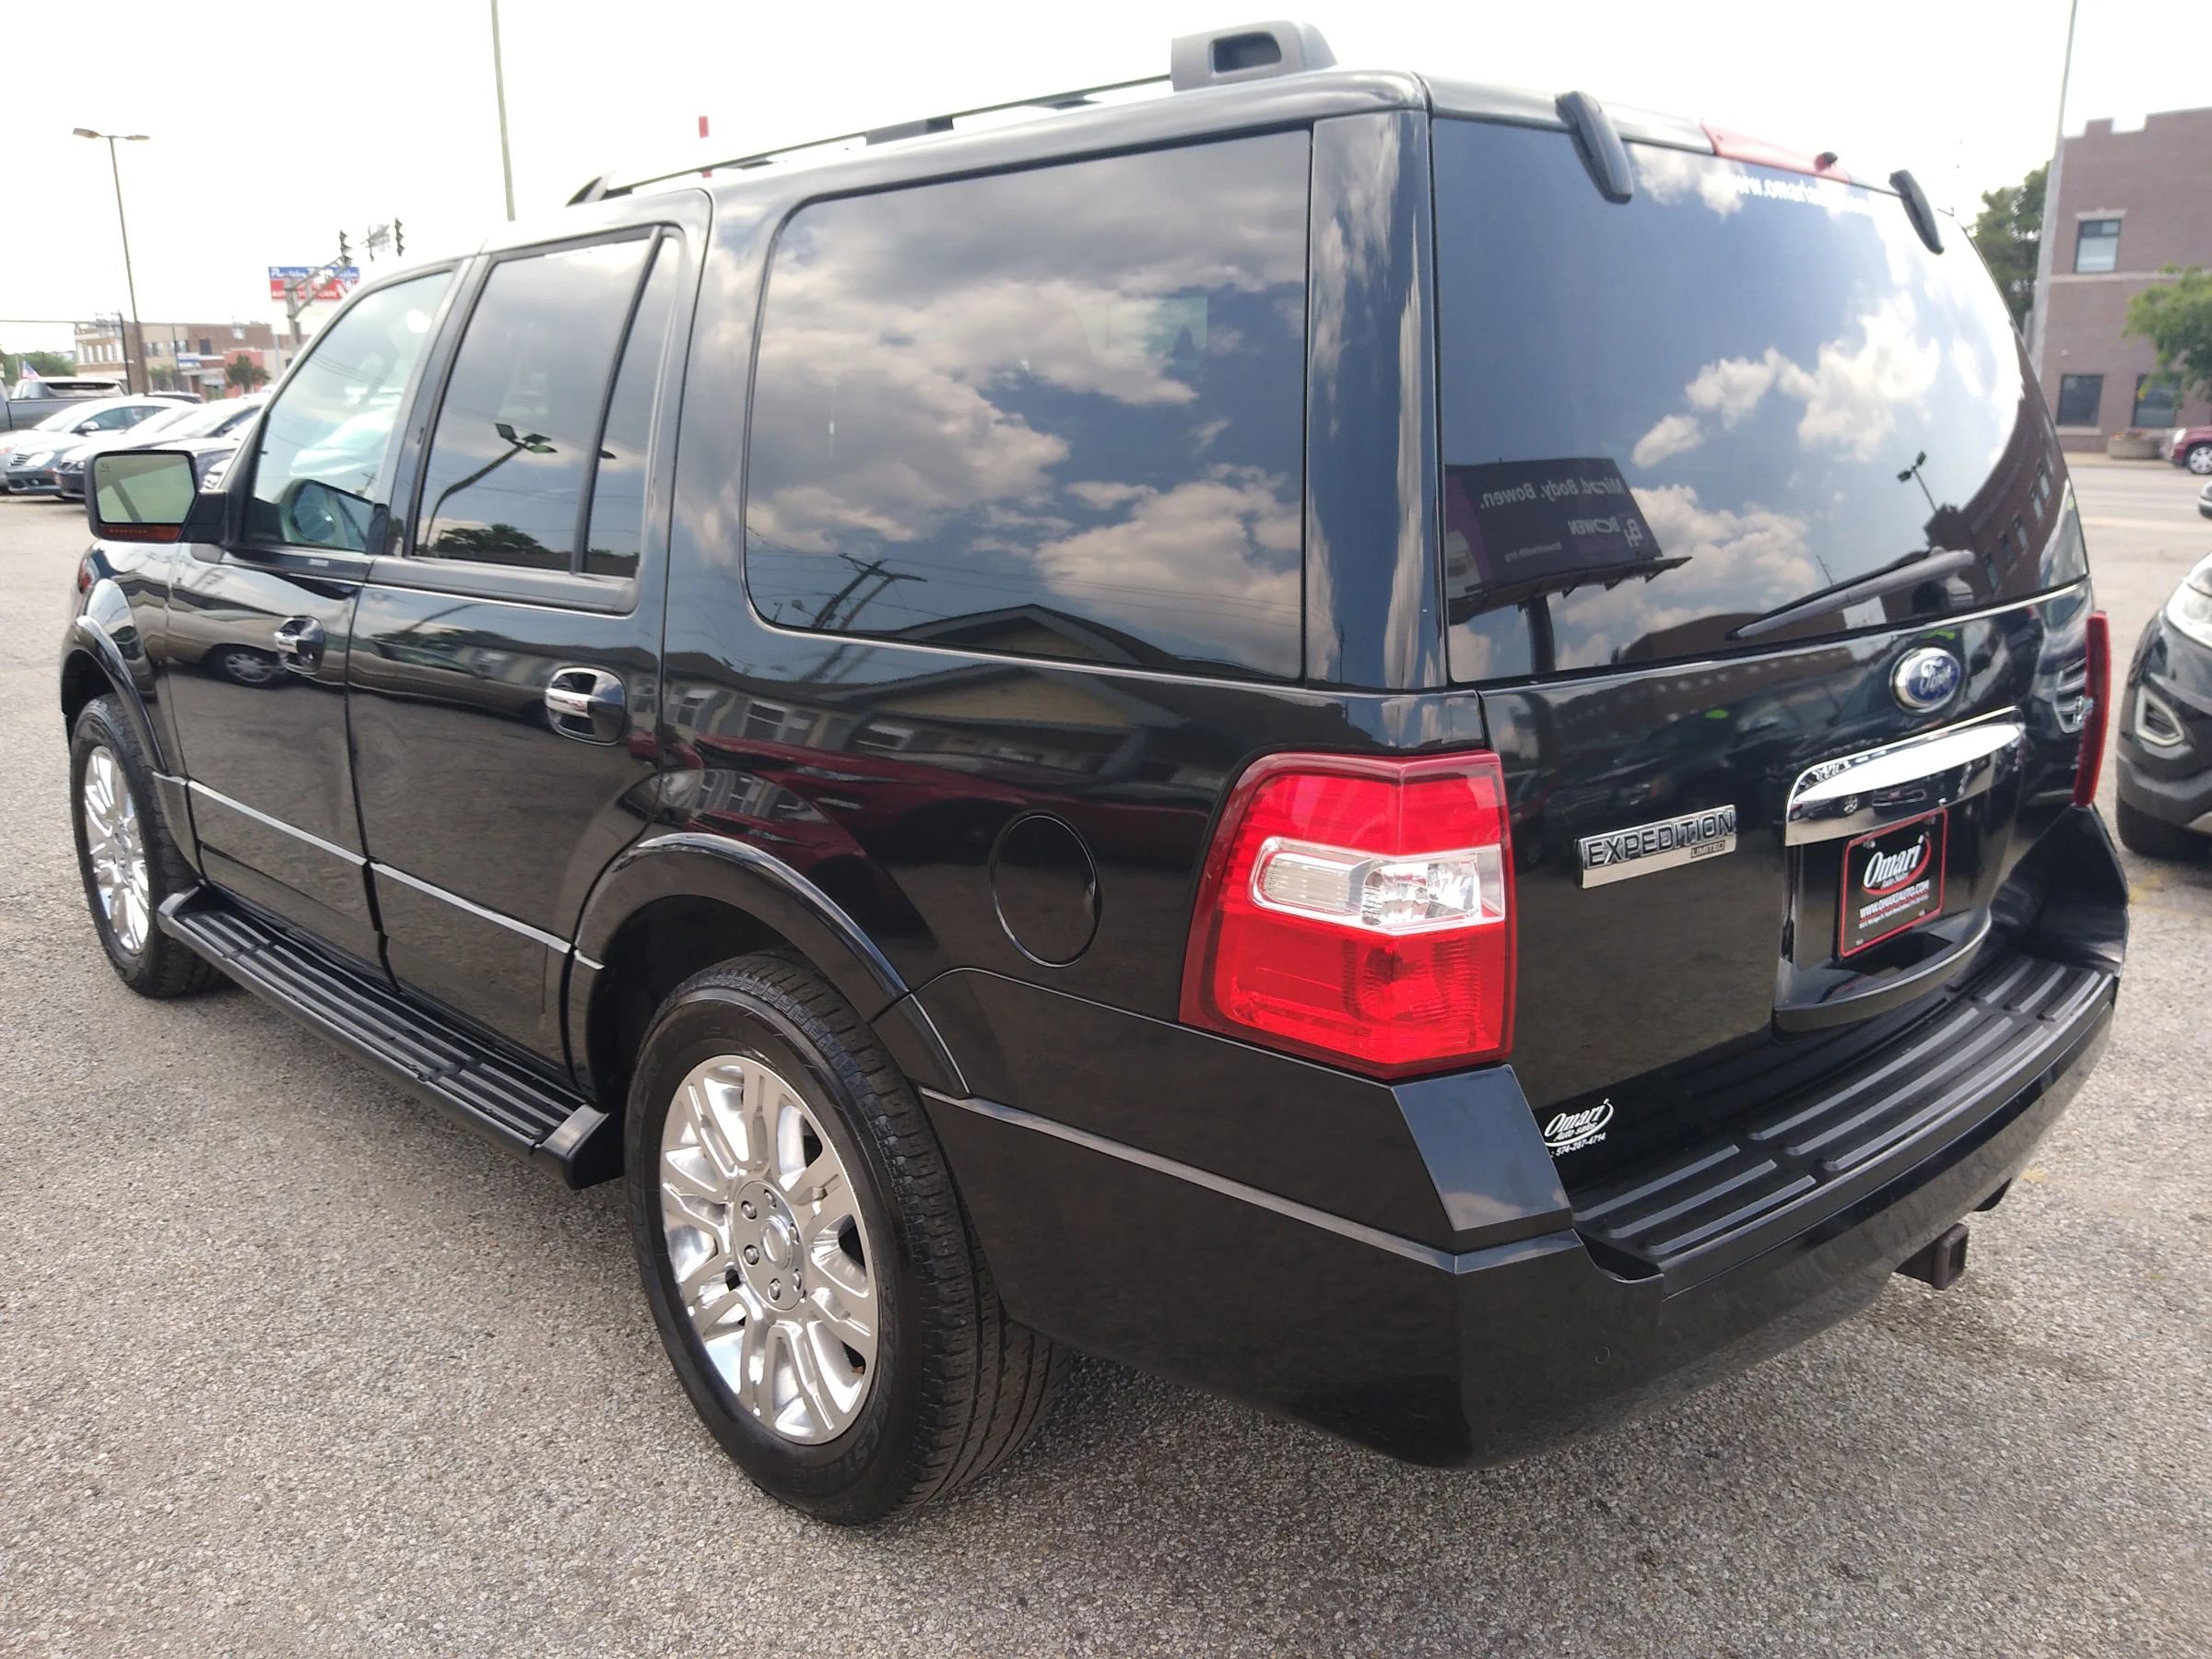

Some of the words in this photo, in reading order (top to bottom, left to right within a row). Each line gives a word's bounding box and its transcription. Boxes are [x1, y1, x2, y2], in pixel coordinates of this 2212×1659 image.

[1586, 810, 1736, 869] EXPEDITION
[1690, 840, 1726, 858] LIMITED
[1864, 834, 1924, 888] Omari
[1544, 1098, 1610, 1136] Omari
